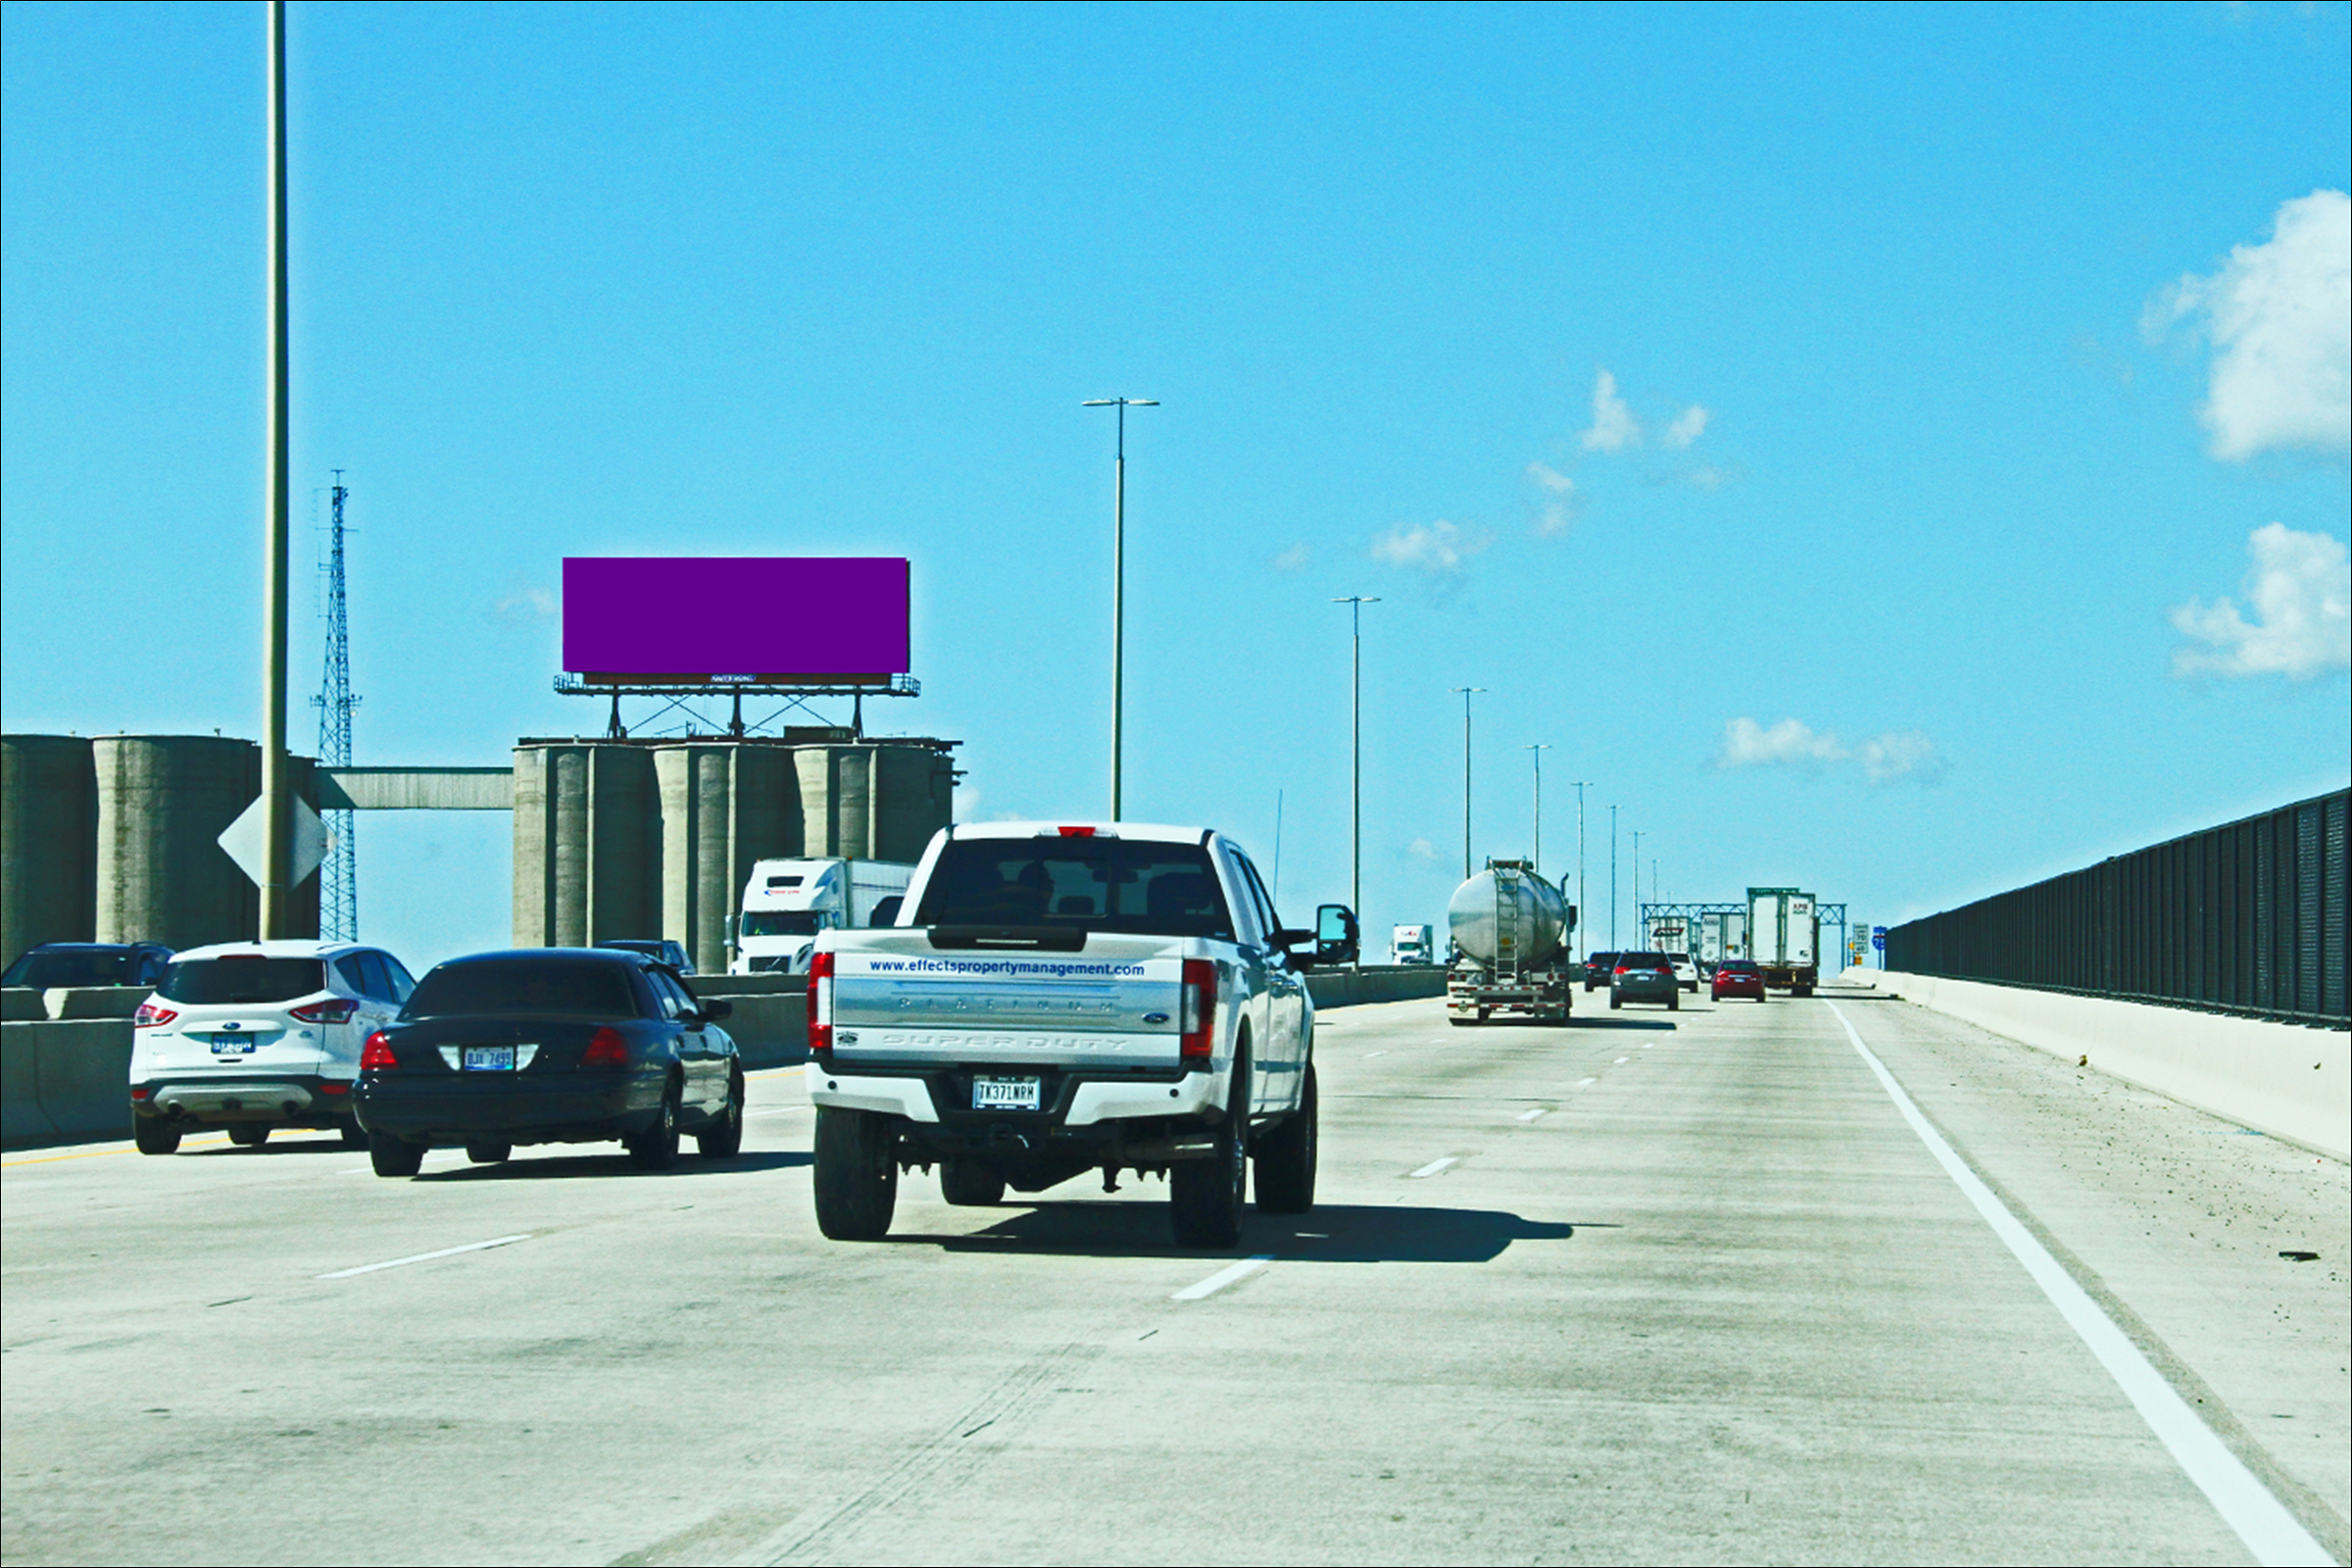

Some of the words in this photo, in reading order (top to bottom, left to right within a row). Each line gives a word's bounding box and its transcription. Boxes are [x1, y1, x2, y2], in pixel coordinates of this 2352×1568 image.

[869, 958, 1145, 977] www.effectspropertymanagement.com
[899, 997, 1114, 1012] PLATINUM
[882, 1033, 1017, 1049] SUPER
[1025, 1037, 1129, 1052] DUTY
